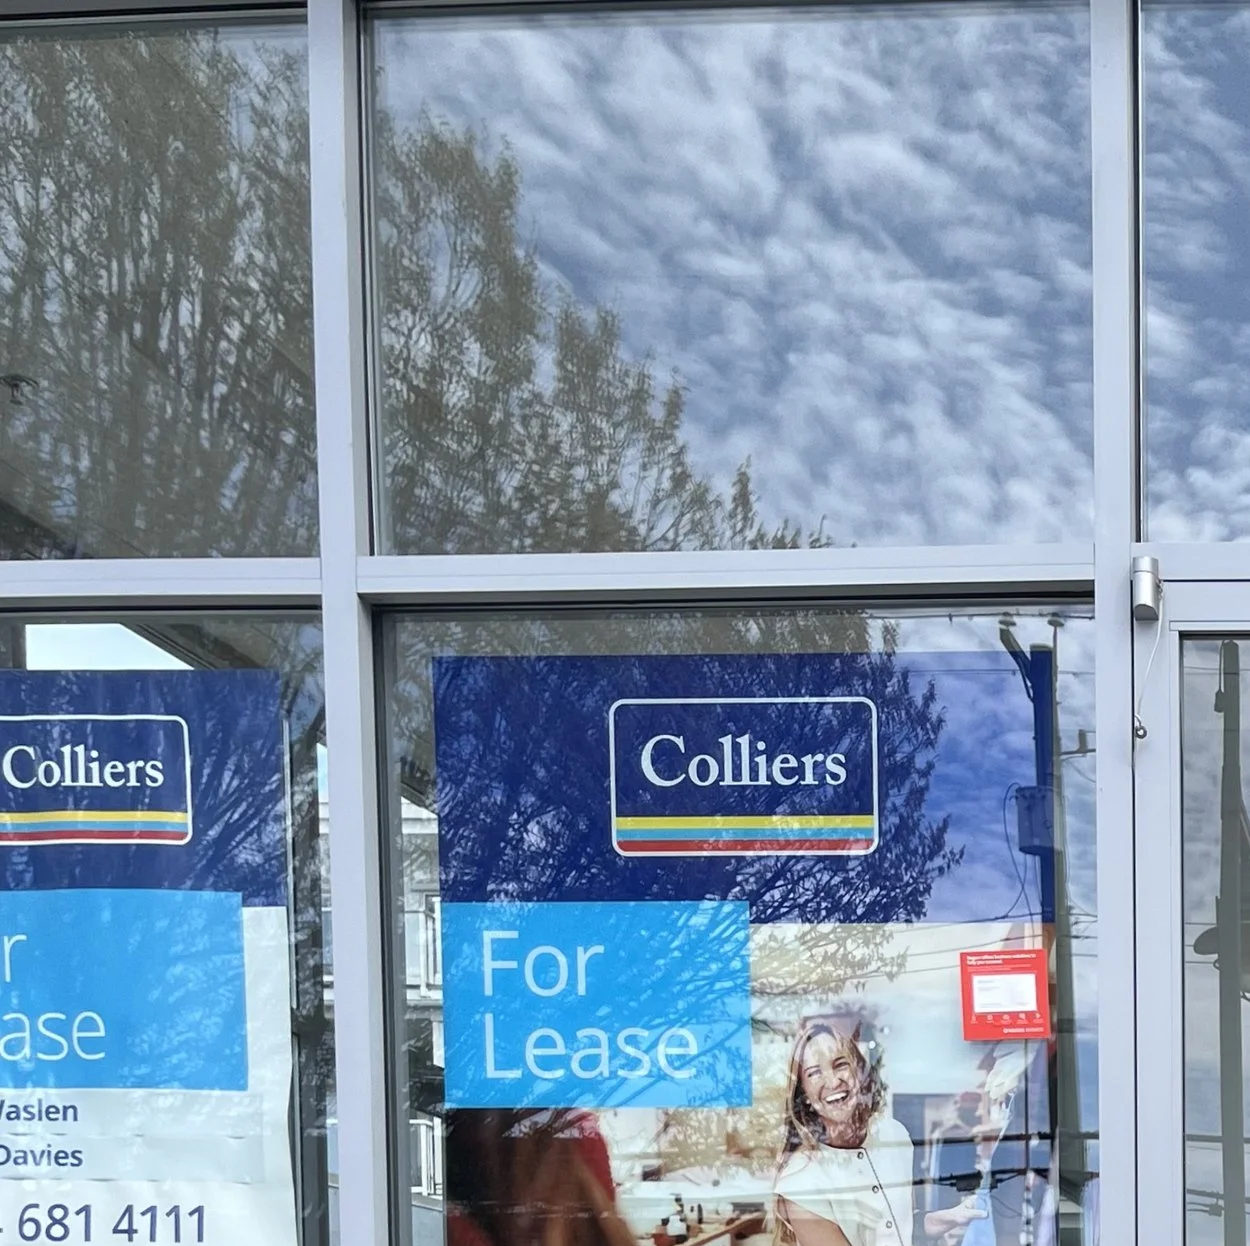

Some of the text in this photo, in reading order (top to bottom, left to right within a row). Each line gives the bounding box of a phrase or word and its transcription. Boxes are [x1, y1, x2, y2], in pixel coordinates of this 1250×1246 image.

[2, 743, 165, 789] Colliers
[640, 733, 847, 787] Colliers
[482, 930, 605, 997] For
[0, 1010, 106, 1061] ase
[484, 1012, 699, 1080] Lease
[0, 1098, 78, 1121] aslen
[18, 1203, 205, 1243] 681 4111
